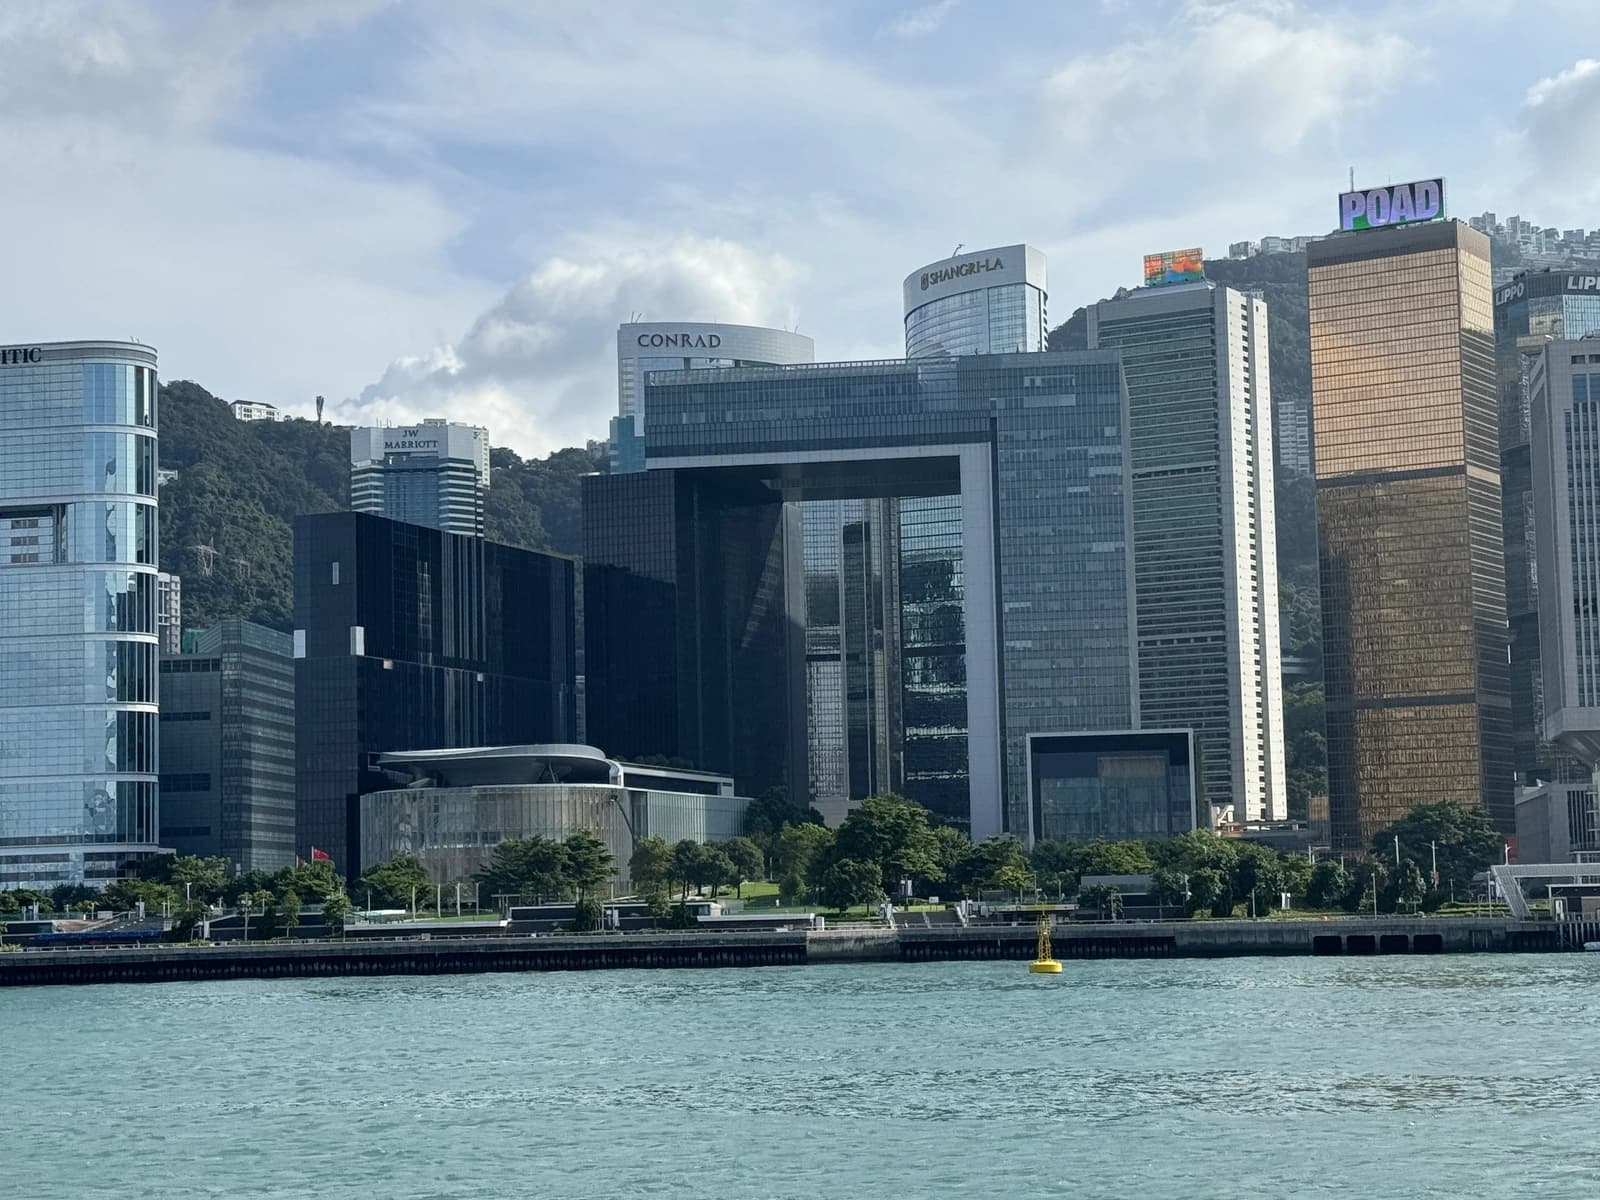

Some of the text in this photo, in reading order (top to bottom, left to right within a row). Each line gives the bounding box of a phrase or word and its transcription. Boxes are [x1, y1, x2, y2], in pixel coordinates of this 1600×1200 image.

[1342, 181, 1440, 230] POAD
[930, 257, 1004, 285] SHANGRI-LA
[1496, 282, 1524, 306] LIPPO
[637, 333, 721, 348] CONRAD
[402, 430, 419, 438] JW
[384, 440, 438, 449] MARRIOTT
